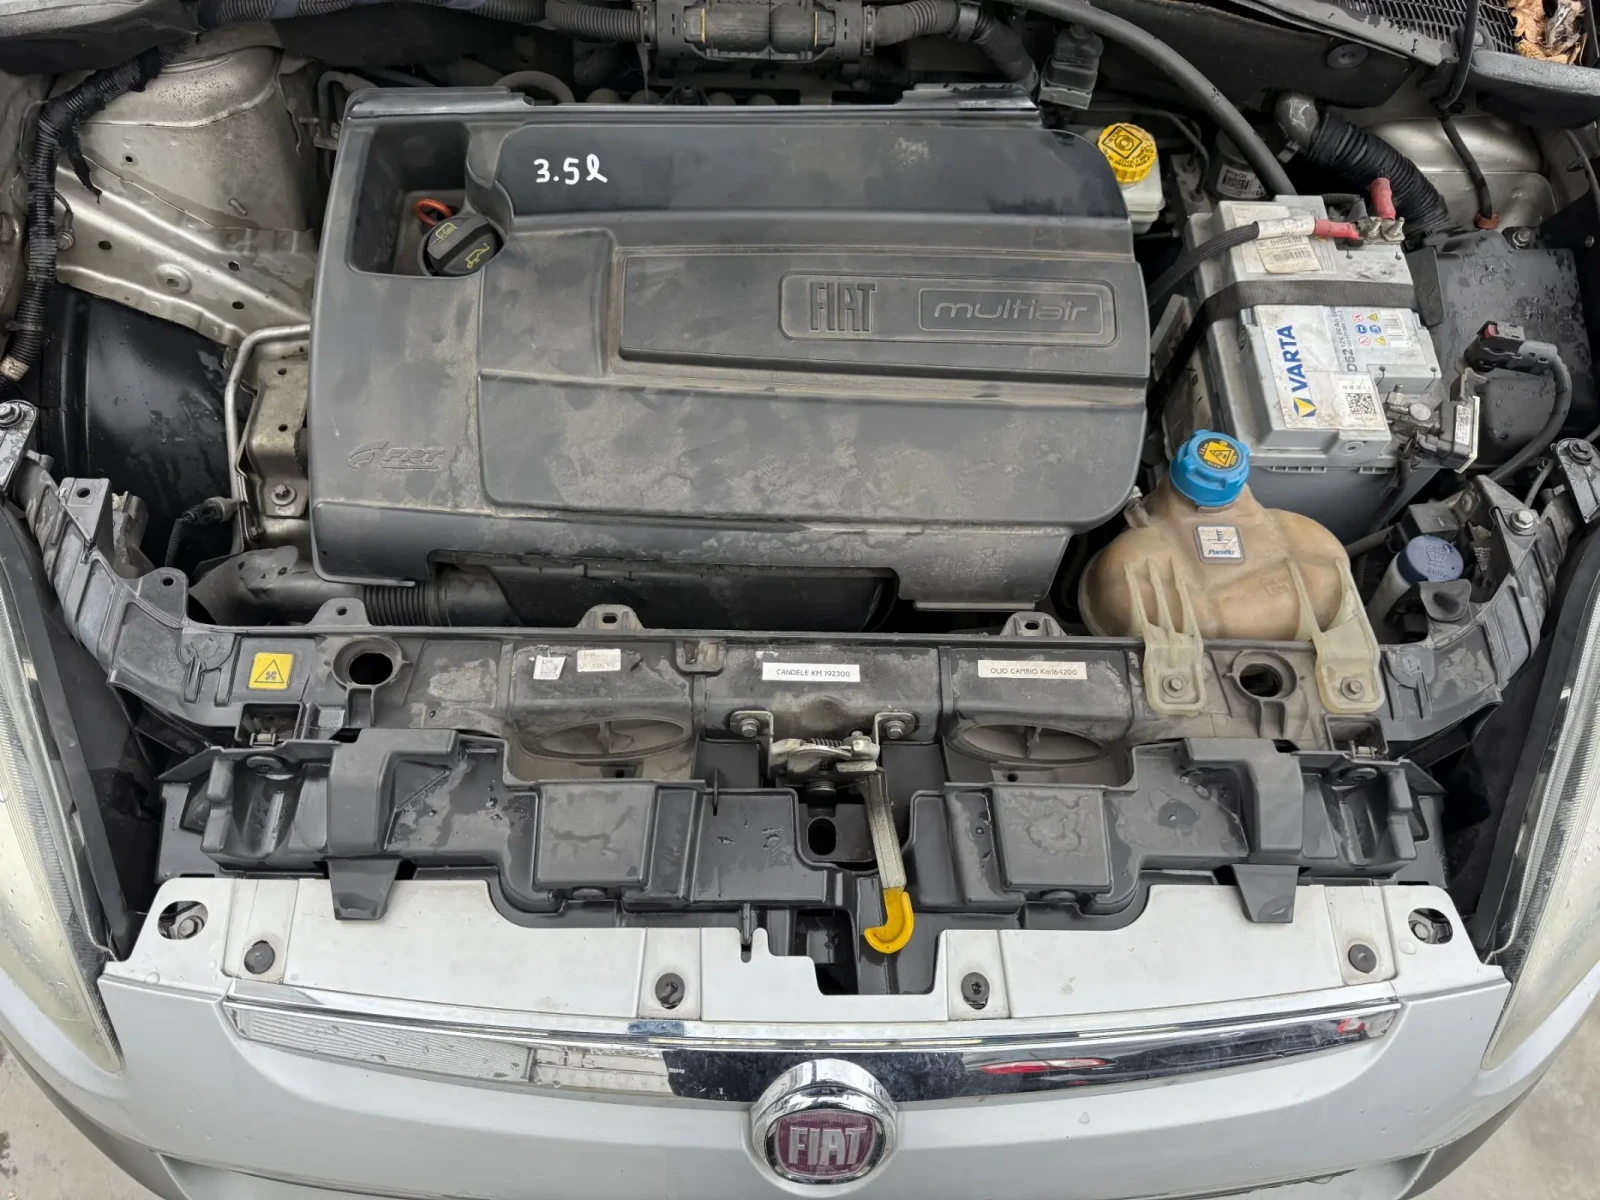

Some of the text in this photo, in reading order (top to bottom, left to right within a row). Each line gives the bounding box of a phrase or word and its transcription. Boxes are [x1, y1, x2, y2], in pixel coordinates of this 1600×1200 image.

[808, 281, 877, 333] FIAT
[934, 299, 1088, 321] multiair
[1277, 324, 1308, 393] VARTA
[1342, 349, 1358, 372] D52
[382, 447, 445, 463] FPT
[776, 668, 810, 677] CANDELE
[824, 670, 851, 678] 192300
[990, 667, 1009, 675] OLIO
[1010, 667, 1038, 675] CAMBIO
[788, 1125, 868, 1166] FIAT
